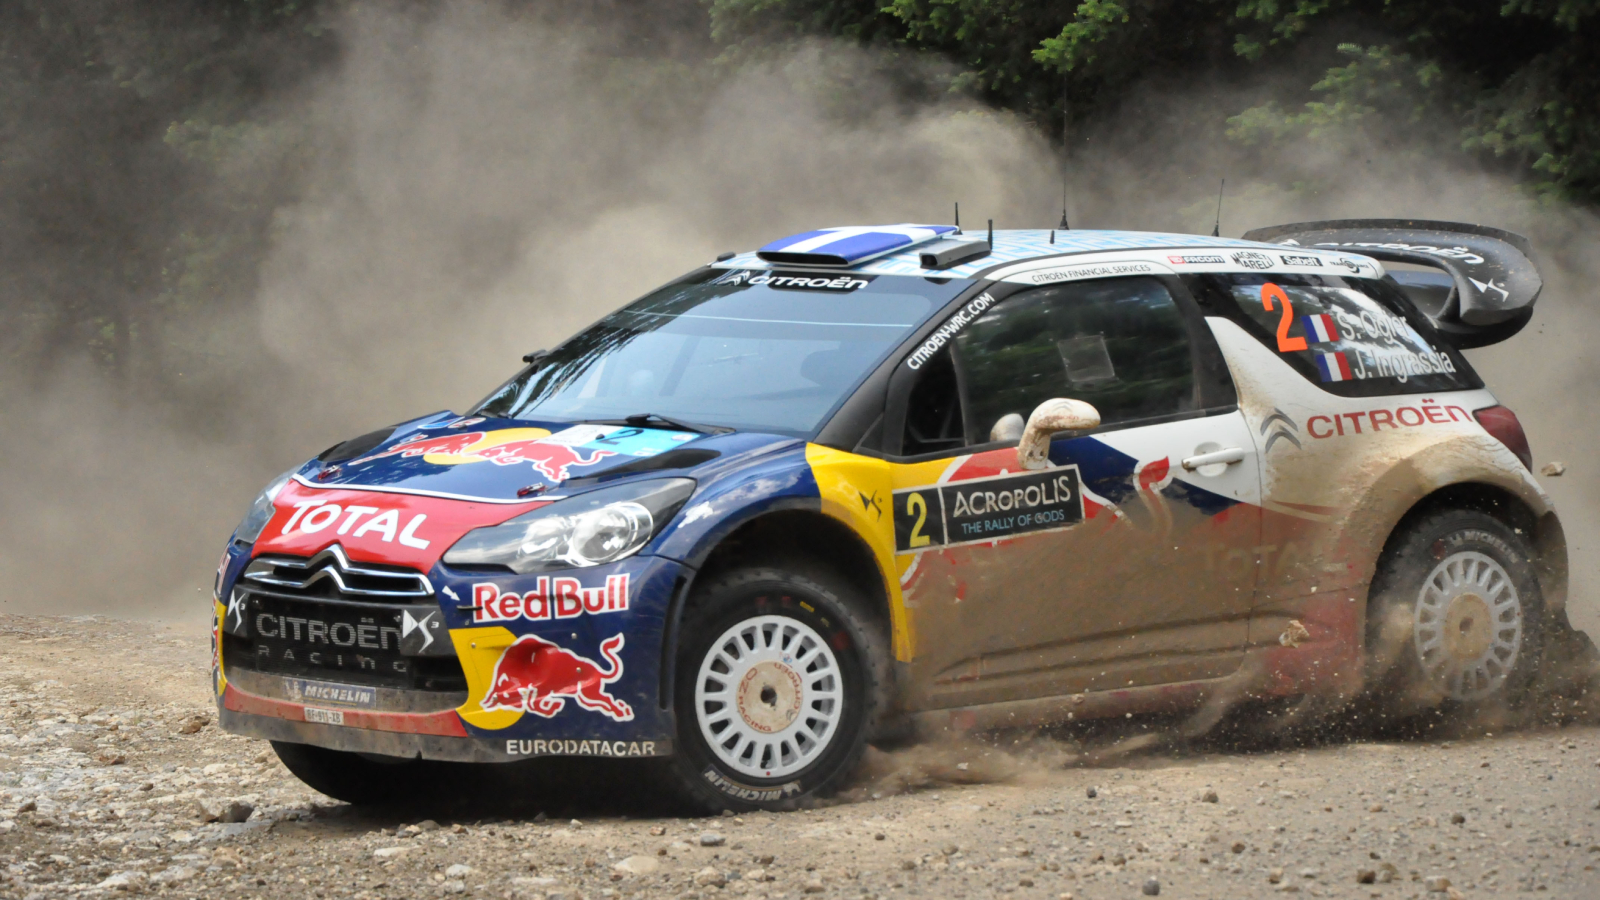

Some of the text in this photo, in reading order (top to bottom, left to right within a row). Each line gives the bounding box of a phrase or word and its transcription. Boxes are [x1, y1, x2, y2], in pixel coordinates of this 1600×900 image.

[1032, 264, 1152, 283] CITROEN FINANCIAL SERVICES
[1282, 255, 1320, 266] Sabelt
[906, 291, 996, 371] CITROEN-WRC.COM
[1260, 282, 1308, 352] 2
[1336, 309, 1409, 345] S. Ogier
[1354, 345, 1457, 384] J. Ingrassia
[597, 428, 644, 446] 2
[953, 475, 1072, 518] ACROPOLIS
[281, 499, 431, 550] TOTAL
[906, 491, 931, 548] 2
[961, 509, 1065, 534] THE RALLY OF GODS
[473, 573, 630, 623] Red Bull
[304, 684, 371, 703] MICHELIN
[506, 739, 656, 756] EURODATACAR
[704, 769, 782, 801] MICHELIN
